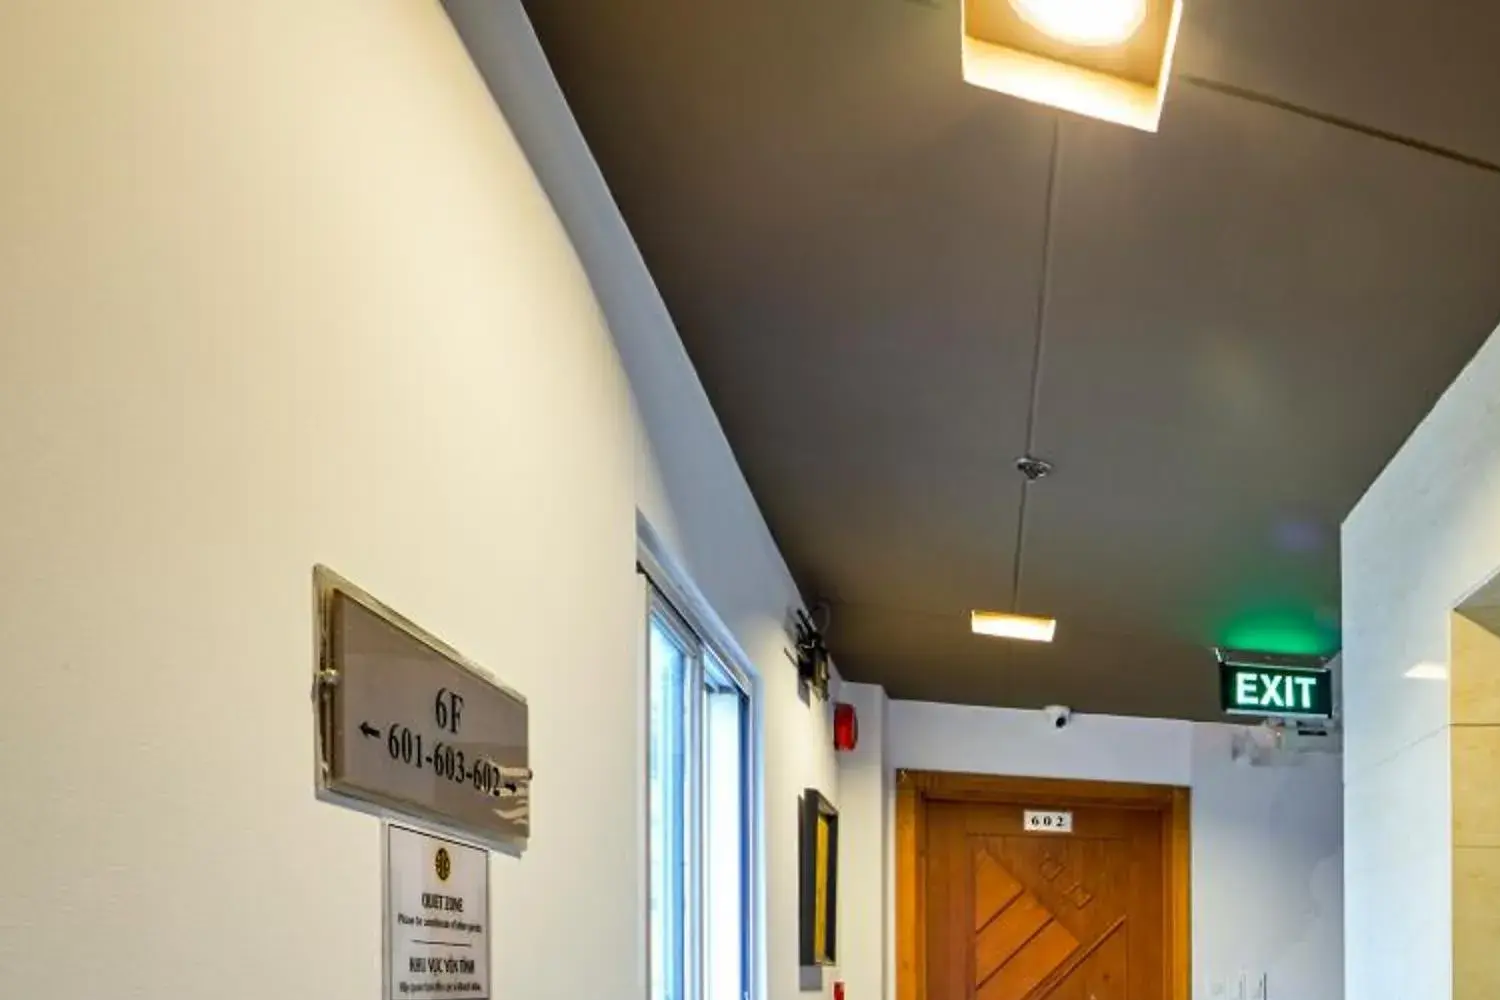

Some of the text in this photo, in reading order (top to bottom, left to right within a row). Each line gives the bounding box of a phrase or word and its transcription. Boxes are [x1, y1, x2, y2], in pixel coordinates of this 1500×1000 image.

[1236, 671, 1317, 709] EXIT
[435, 687, 465, 734] 6F
[388, 723, 499, 796] 601-603-602
[1031, 815, 1065, 827] 602
[422, 892, 443, 910] QUIET
